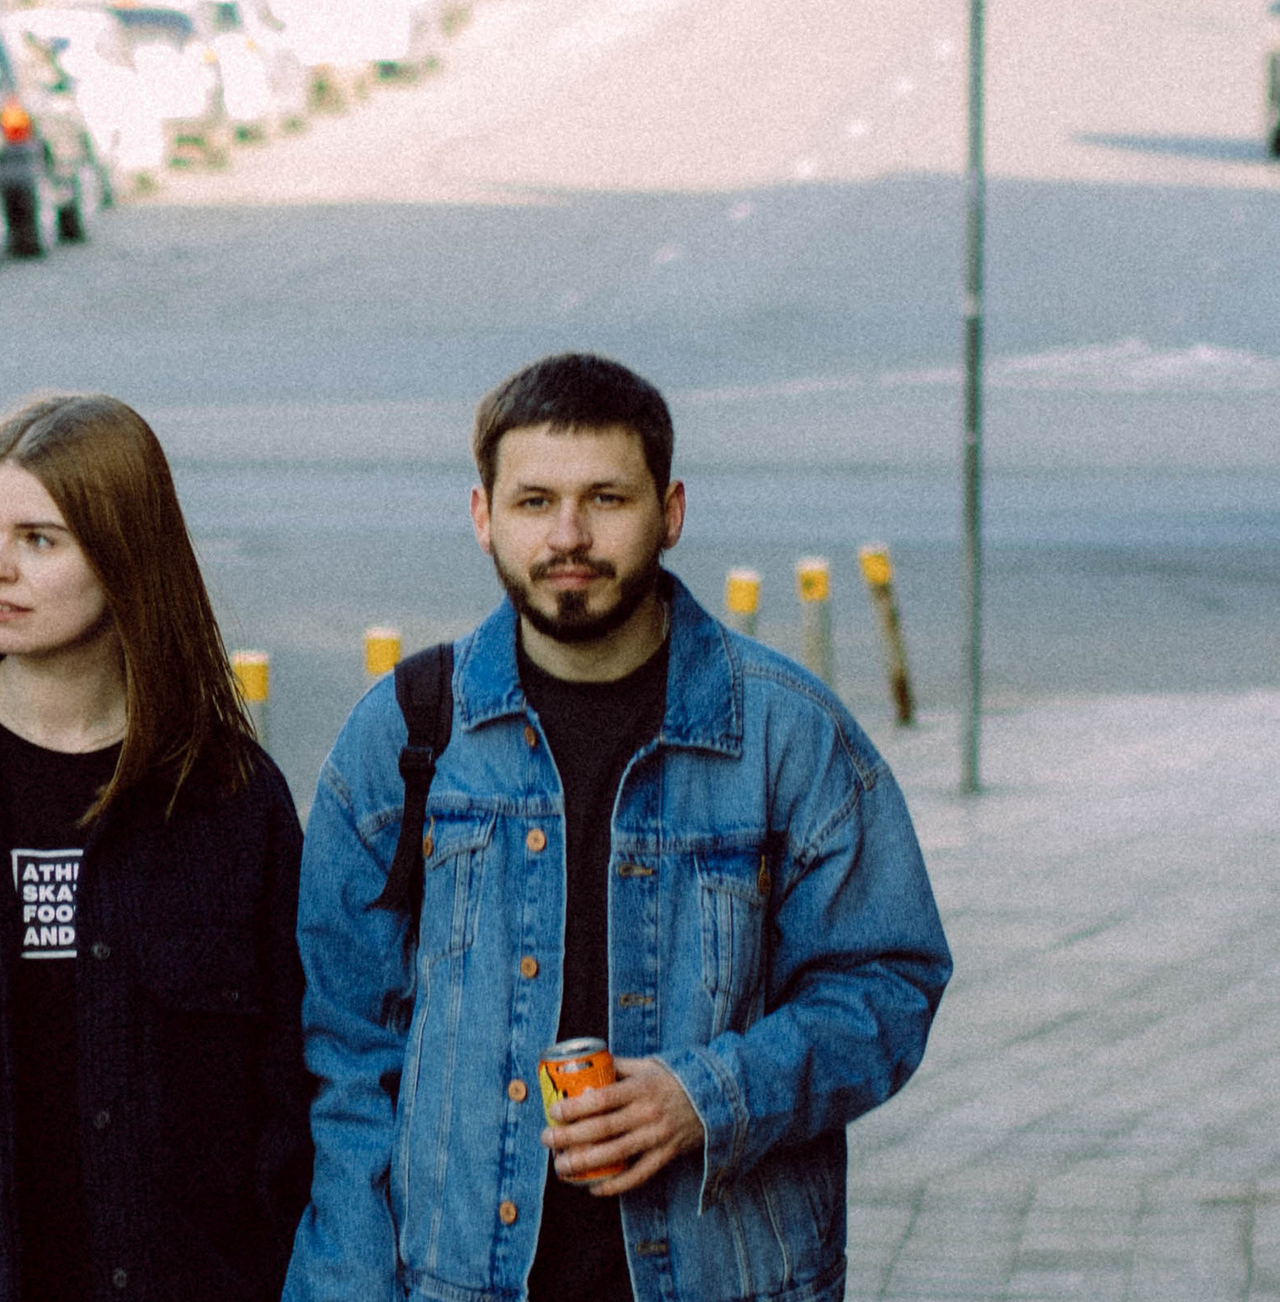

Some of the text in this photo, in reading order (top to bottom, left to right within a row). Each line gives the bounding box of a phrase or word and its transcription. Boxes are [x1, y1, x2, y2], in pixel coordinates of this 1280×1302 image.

[23, 884, 77, 902] SKA
[23, 904, 76, 923] FOO
[23, 925, 76, 946] AND
